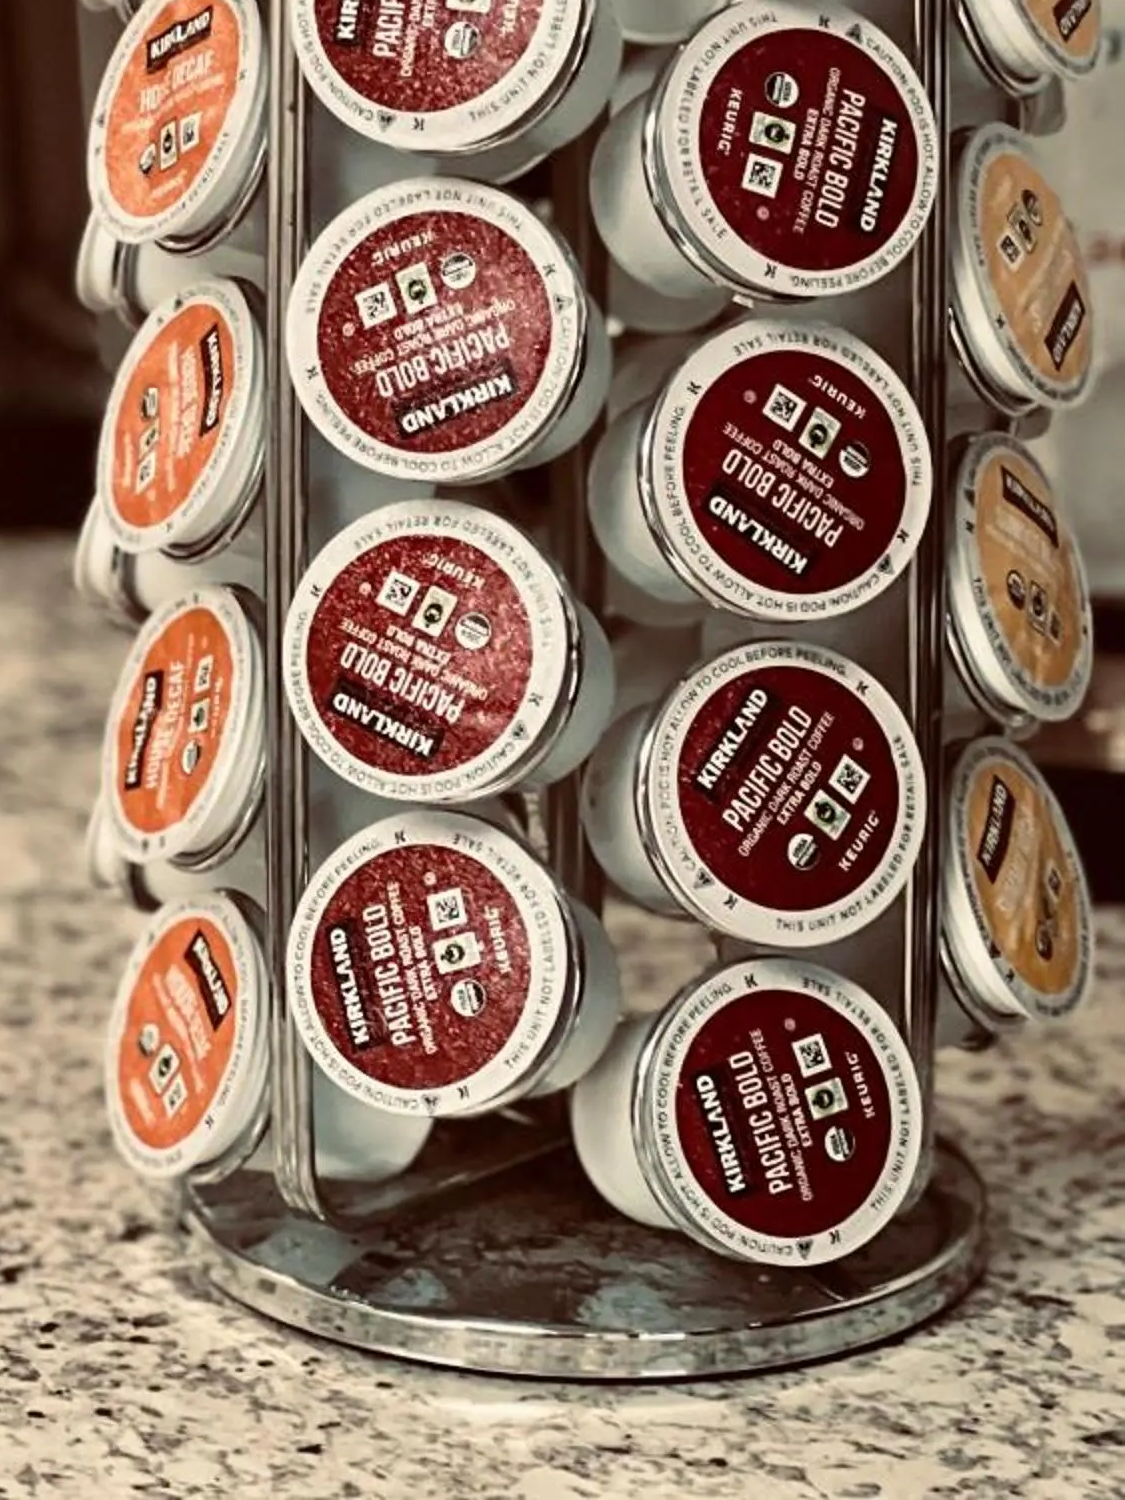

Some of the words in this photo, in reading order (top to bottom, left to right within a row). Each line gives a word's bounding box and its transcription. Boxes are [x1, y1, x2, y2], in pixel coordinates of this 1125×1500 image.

[150, 10, 212, 61] KIRKLAND
[718, 20, 749, 46] UNIT
[747, 10, 778, 30] THIS
[399, 23, 420, 78] ORGANIC
[697, 39, 723, 68] NOT
[675, 64, 706, 124] LABELED
[819, 66, 841, 118] ORGANIC
[905, 85, 925, 116] POD
[676, 127, 690, 155] FOR
[798, 107, 817, 147] EXTRA
[812, 116, 830, 150] DARK
[826, 88, 866, 172] PACIFIC
[917, 116, 930, 131] IS
[679, 159, 705, 207] RETAIL
[790, 147, 808, 182] BOLD
[803, 149, 823, 189] ROAST
[858, 116, 898, 232] KIRKLAND
[813, 168, 848, 228] BOLD
[916, 165, 934, 213] ALLOW
[698, 206, 728, 241] SALE
[791, 189, 814, 235] COFFEE
[908, 211, 924, 233] TO
[885, 227, 915, 263] COOL
[844, 253, 890, 288] BEFORE
[391, 317, 425, 340] BOLD
[425, 301, 464, 326] EXTRA
[432, 317, 465, 339] DARK
[463, 295, 515, 327] ORGANIC
[393, 330, 433, 355] ROAST
[427, 319, 511, 375] PACIFIC
[731, 334, 764, 357] SALE
[764, 329, 808, 346] RETAIL
[812, 333, 839, 354] FOR
[351, 346, 395, 374] COFFEE
[372, 353, 431, 398] BOLD
[839, 343, 890, 392] LABELED
[396, 371, 514, 435] KIRKLAND
[885, 388, 907, 419] NOT
[722, 417, 764, 455] COFFEE
[770, 435, 802, 464] BOLD
[900, 420, 919, 453] UNIT
[719, 443, 776, 498] BOLD
[760, 446, 797, 479] ROAST
[799, 457, 835, 488] EXTRA
[908, 455, 922, 486] THIS
[661, 464, 684, 518] BEFORE
[794, 470, 824, 499] DARK
[768, 479, 844, 548] PACIFIC
[820, 490, 866, 529] ORGANIC
[672, 517, 702, 556] COOL
[705, 491, 811, 576] KIRKLAND
[694, 552, 715, 573] TO
[710, 567, 754, 602] ALLOW
[784, 600, 797, 613] IS
[800, 599, 826, 613] POD
[339, 615, 379, 645] COFFEE
[376, 635, 413, 662] ROAST
[385, 623, 417, 646] BOLD
[338, 639, 393, 686] BOLD
[411, 652, 443, 677] DARK
[416, 638, 453, 664] EXTRA
[387, 665, 467, 725] PACIFIC
[439, 667, 490, 701] ORGANIC
[125, 673, 157, 786] KIRKLAND
[328, 687, 434, 757] KIRKLAND
[693, 684, 773, 792] KIRKLAND
[720, 751, 784, 834] PACIFIC
[766, 703, 815, 762] BOLD
[737, 808, 775, 860] ORGANIC
[766, 781, 792, 814] DARK
[784, 747, 814, 785] ROAST
[806, 711, 838, 752] COFFEE
[777, 788, 805, 827] EXTRA
[798, 759, 823, 792] BOLD
[385, 880, 406, 926] COFFEE
[360, 902, 395, 962] BOLD
[396, 925, 415, 967] ROAST
[410, 924, 428, 959] BOLD
[327, 924, 370, 1044] KIRKLAND
[406, 966, 424, 1001] DARK
[419, 960, 439, 1001] EXTRA
[374, 960, 417, 1046] PACIFIC
[414, 1000, 437, 1055] ORGANIC
[661, 1016, 692, 1068] BEFORE
[751, 1025, 775, 1072] COFFEE
[654, 1070, 670, 1108] COOL
[727, 1047, 767, 1109] BOLD
[766, 1072, 787, 1113] ROAST
[780, 1070, 799, 1106] BOLD
[654, 1111, 669, 1129] TO
[693, 1070, 748, 1196] KIRKLAND
[779, 1113, 798, 1148] DARK
[791, 1106, 813, 1147] EXTRA
[657, 1131, 685, 1181] ALLOW
[747, 1107, 795, 1195] PACIFIC
[789, 1146, 816, 1200] ORGANIC
[697, 1204, 713, 1222] IS
[708, 1215, 736, 1241] POD
